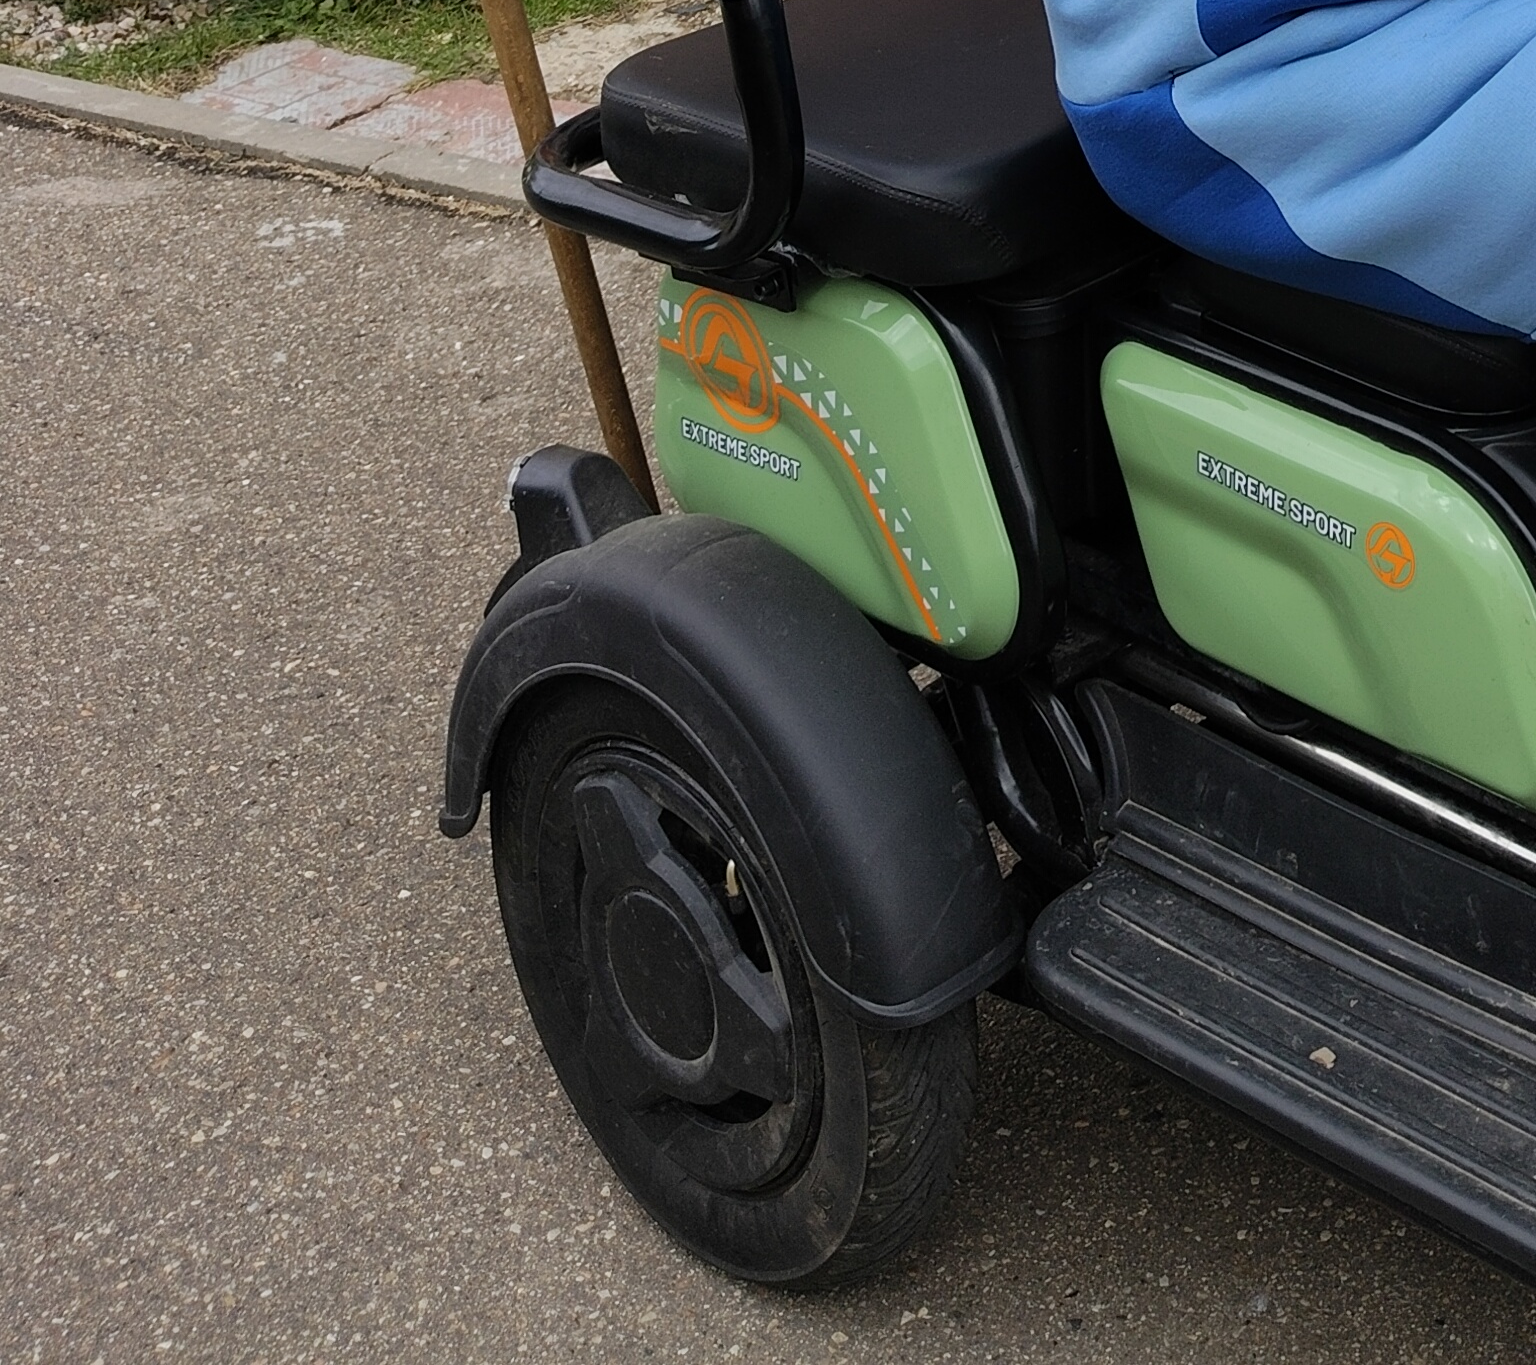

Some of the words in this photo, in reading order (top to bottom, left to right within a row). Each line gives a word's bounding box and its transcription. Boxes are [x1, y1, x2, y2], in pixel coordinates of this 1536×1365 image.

[681, 416, 748, 463] EXTREME
[749, 443, 801, 481] SPORT
[1197, 450, 1287, 517] EXTREME
[1289, 497, 1357, 549] SPORT
